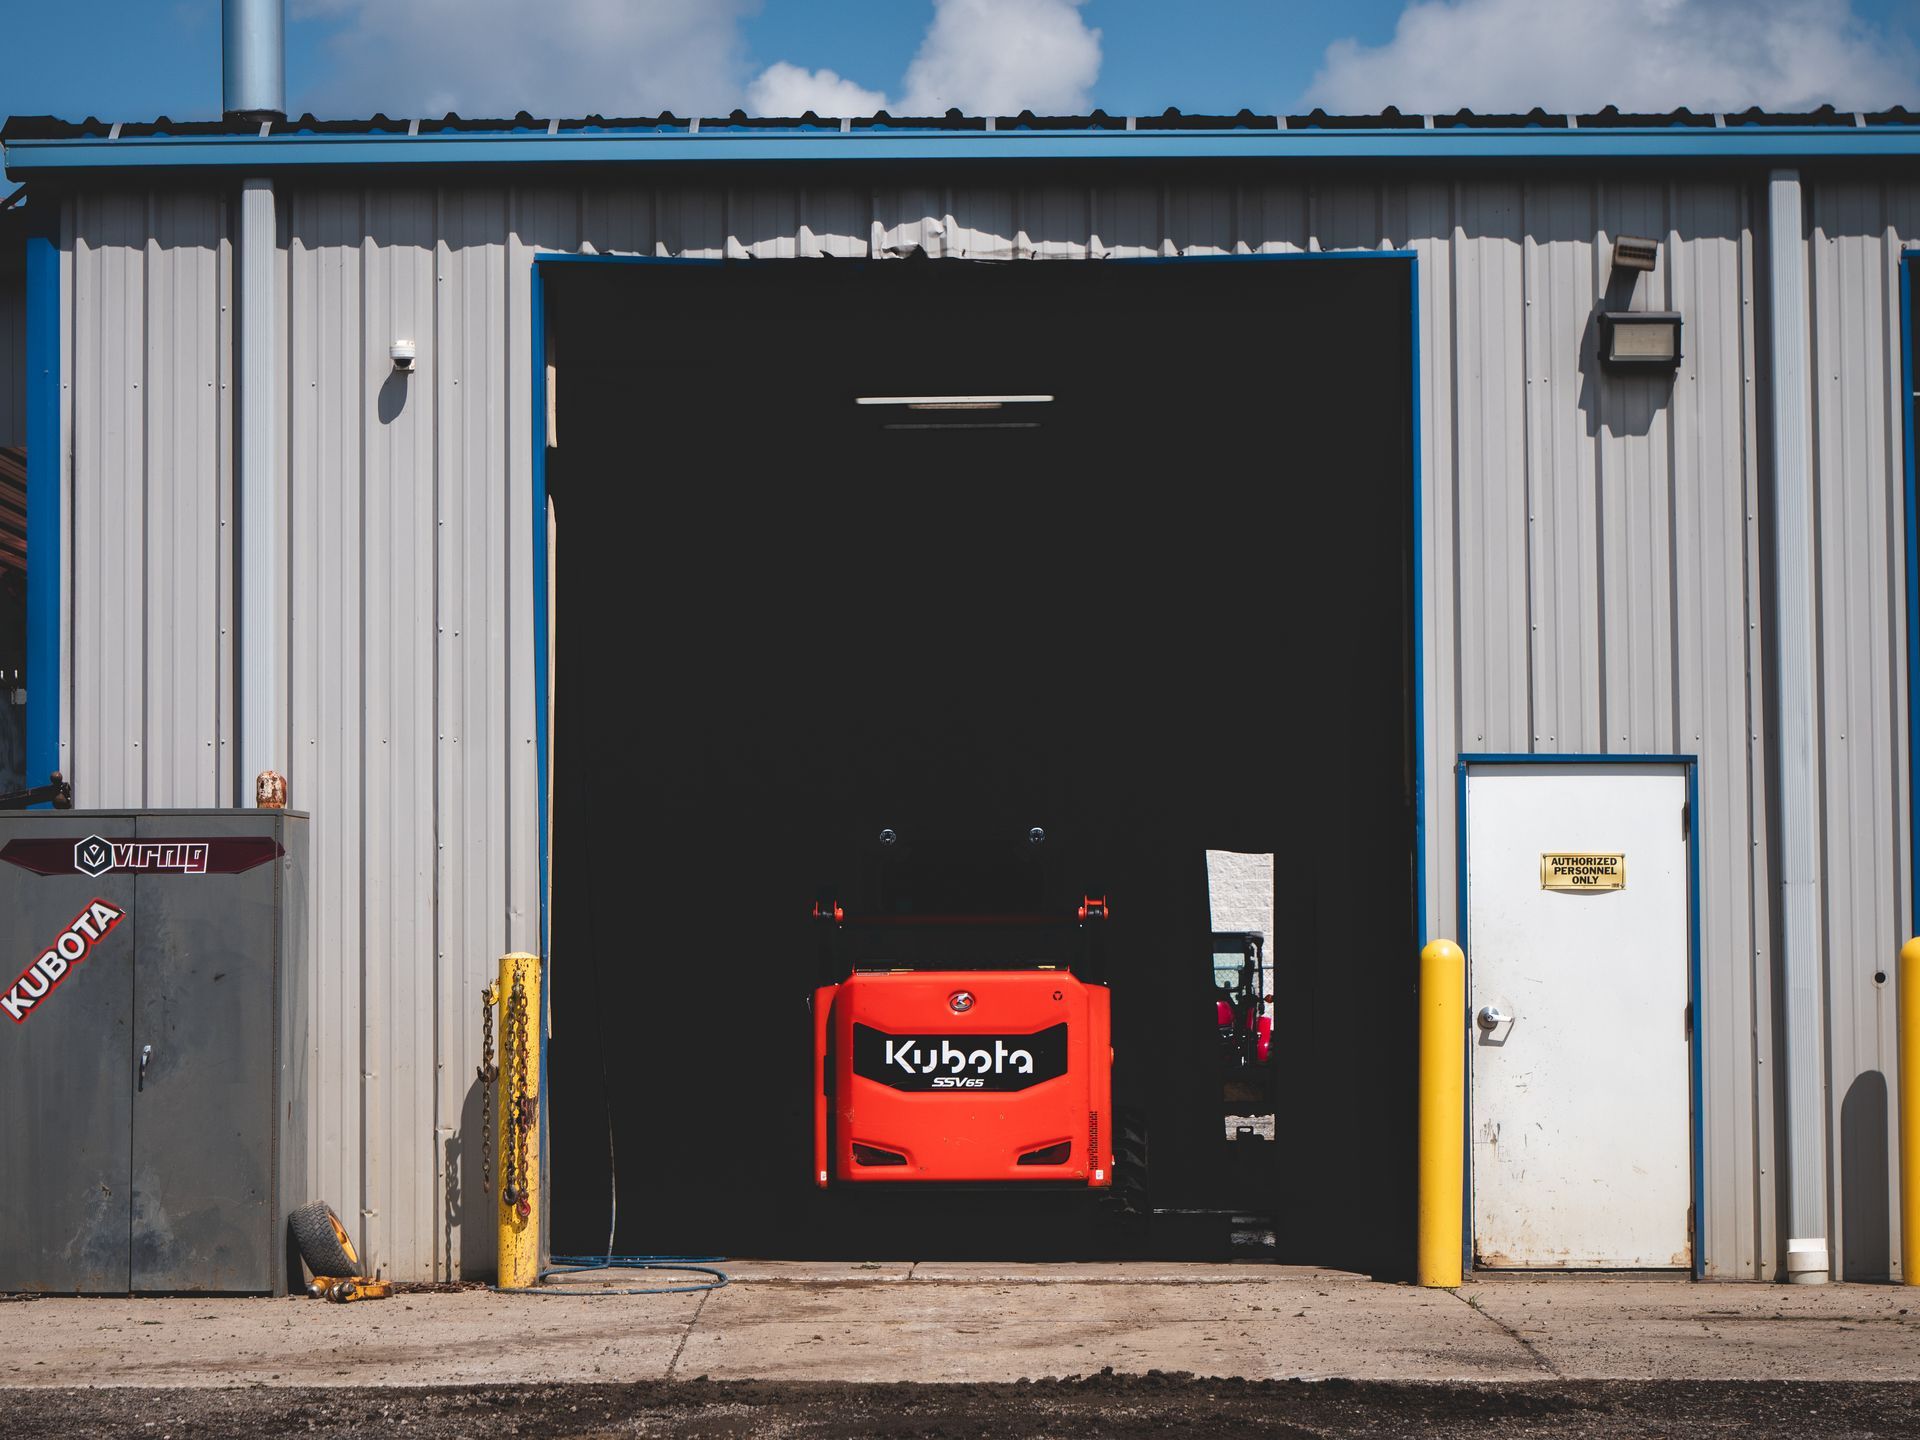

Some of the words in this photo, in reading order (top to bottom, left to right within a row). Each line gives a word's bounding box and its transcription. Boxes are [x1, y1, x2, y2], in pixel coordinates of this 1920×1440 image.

[1551, 857, 1617, 866] AUTHORIZED
[1554, 866, 1617, 875] PERSONNEL
[1572, 875, 1599, 884] ONLY
[1, 902, 120, 1020] KUBOTA
[886, 1040, 1034, 1074] Kubota
[931, 1076, 985, 1088] SSV65
